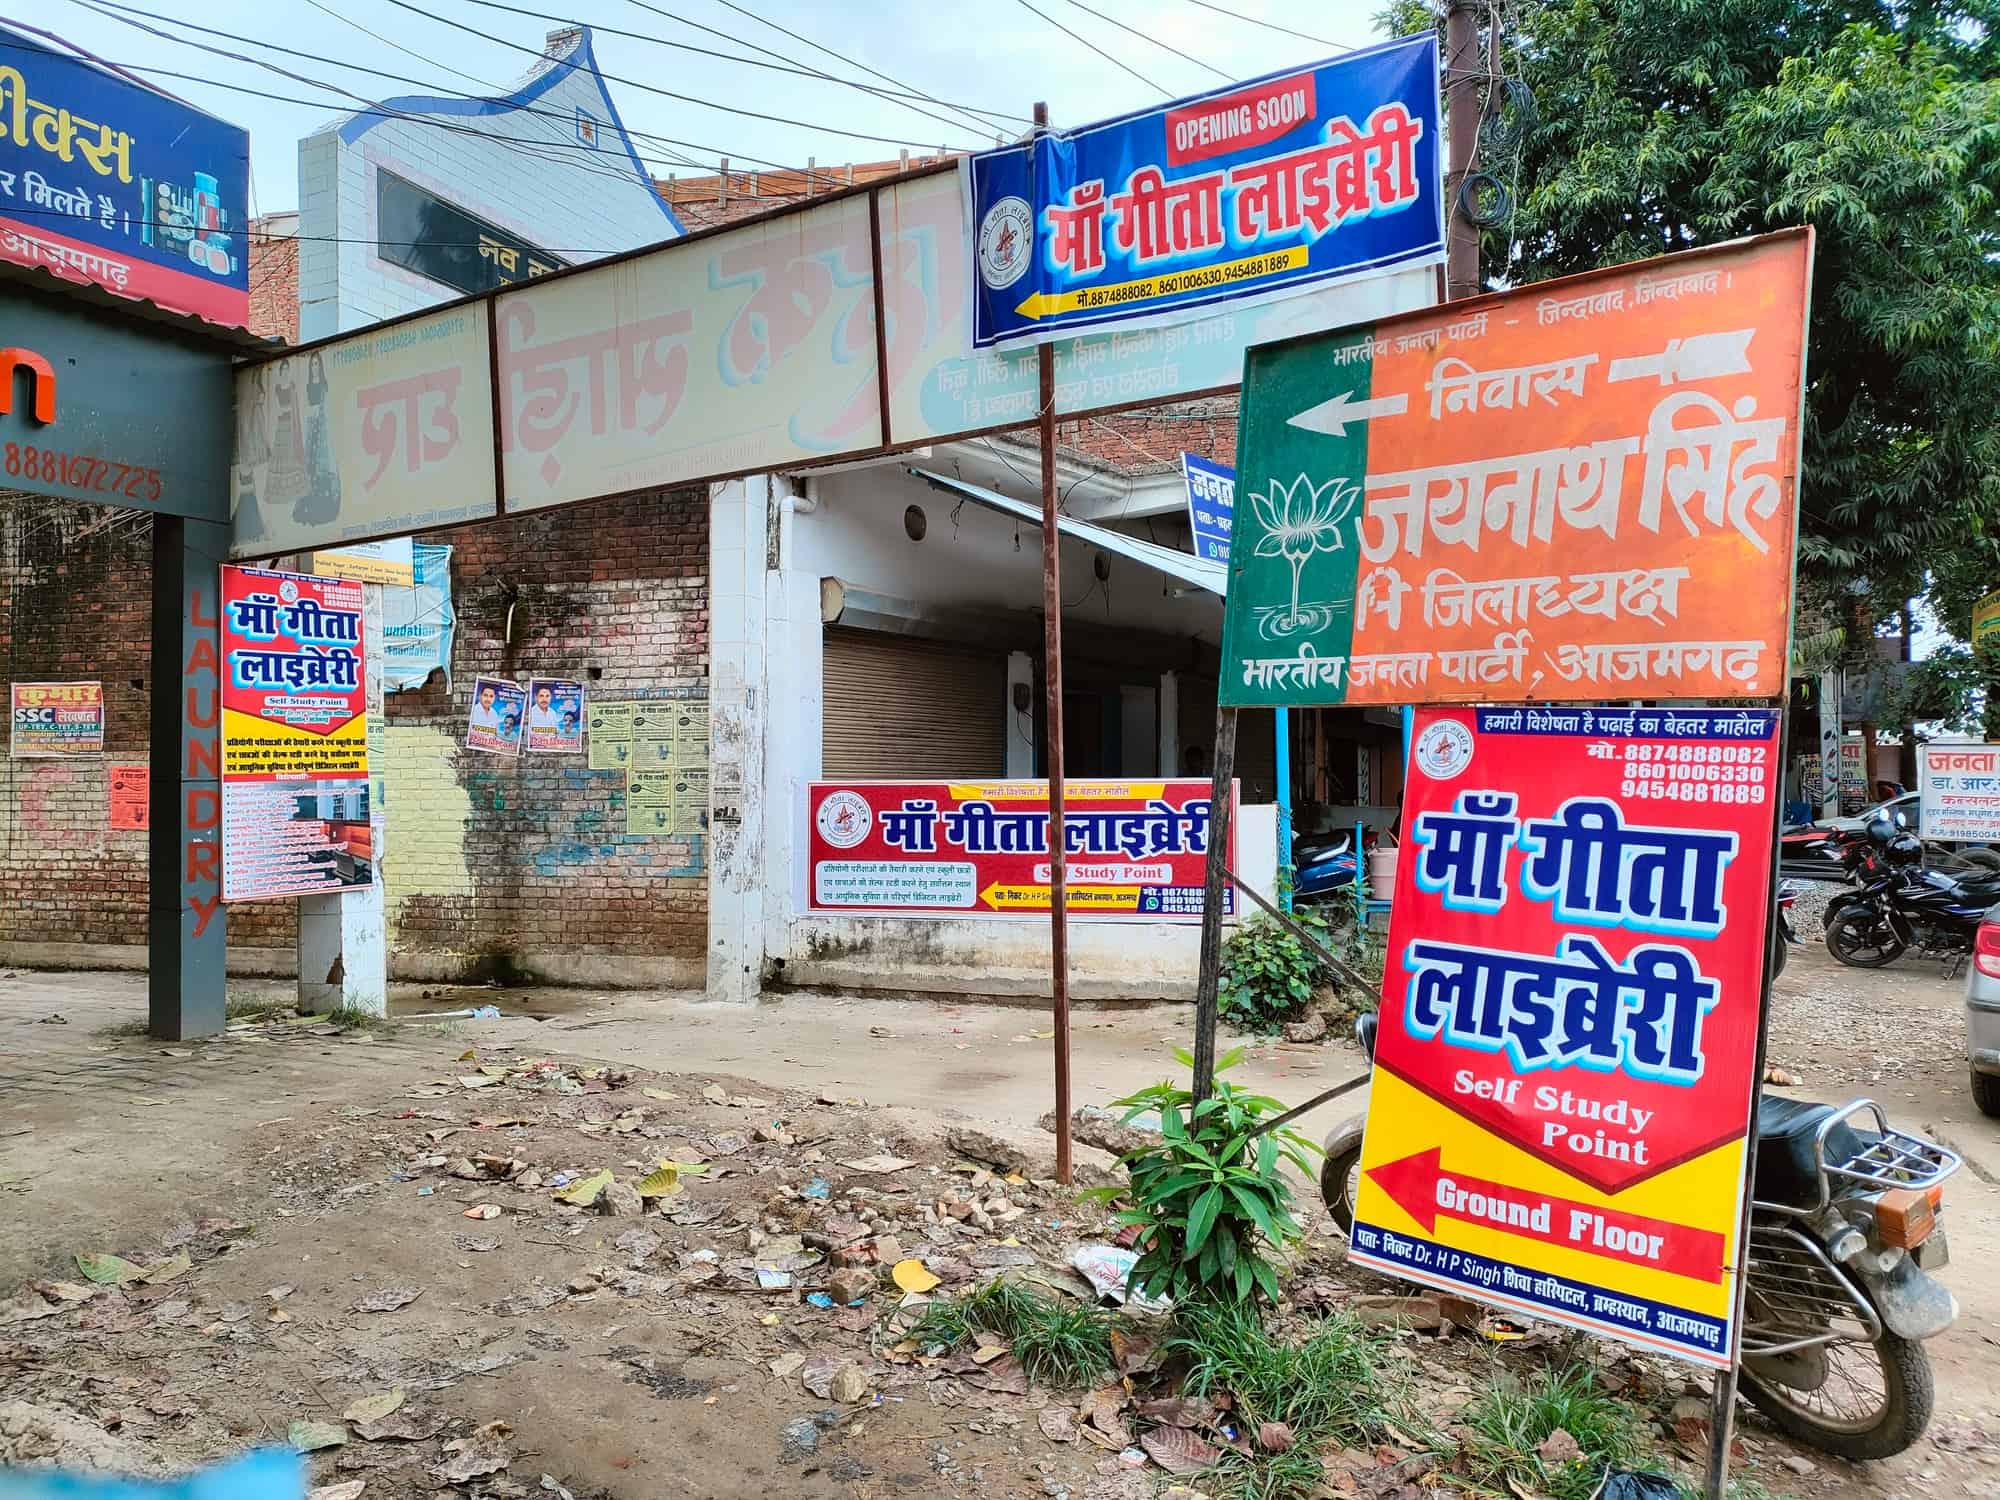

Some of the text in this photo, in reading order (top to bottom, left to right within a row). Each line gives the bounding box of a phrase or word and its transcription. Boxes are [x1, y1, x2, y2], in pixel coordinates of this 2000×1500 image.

[1175, 89, 1307, 152] OPENING SOON
[24, 170, 91, 221] मिलते
[1112, 167, 1225, 261] गीता
[1229, 104, 1422, 239] लाइब्रेरी
[1333, 334, 1392, 367] भारतीय
[1395, 328, 1441, 356] जनता
[1445, 312, 1489, 341] पार्टी
[1425, 353, 1599, 420] निवास
[1355, 390, 1787, 563] जयनाथ सिंह
[231, 593, 279, 637] माँ
[283, 599, 361, 642] गीता
[234, 646, 360, 689] लाइब्रेरी
[1242, 642, 1345, 690] भारतीय
[1345, 652, 1433, 689] जनता
[1544, 640, 1767, 690] आजमगढ़
[15, 708, 53, 723] SSC
[290, 697, 316, 708] Study
[1484, 710, 1766, 737] हमारी विशेषता है पढ़ाई का बेहतर माहौल
[185, 589, 221, 938] LAUNDRY
[1623, 763, 1766, 783] 8601006330
[1928, 752, 1996, 771] जनता
[1620, 780, 1766, 805] 9454881889
[881, 800, 938, 850] माँ
[944, 802, 1048, 851] गीता
[1074, 866, 1118, 881] Study
[1124, 865, 1163, 879] Point
[1420, 792, 1736, 927] माँ गीता
[1411, 936, 1719, 1075] लाइब्रेरी
[1453, 1069, 1654, 1135] Self Study
[1541, 1121, 1650, 1166] Point
[1435, 1177, 1665, 1261] Ground Floor
[1383, 1232, 1414, 1259] निकट
[1414, 1244, 1432, 1265] Dr.
[1436, 1250, 1448, 1269] H
[1450, 1255, 1461, 1272] P
[1462, 1256, 1501, 1286] Singh
[1503, 1266, 1532, 1293] शिवा
